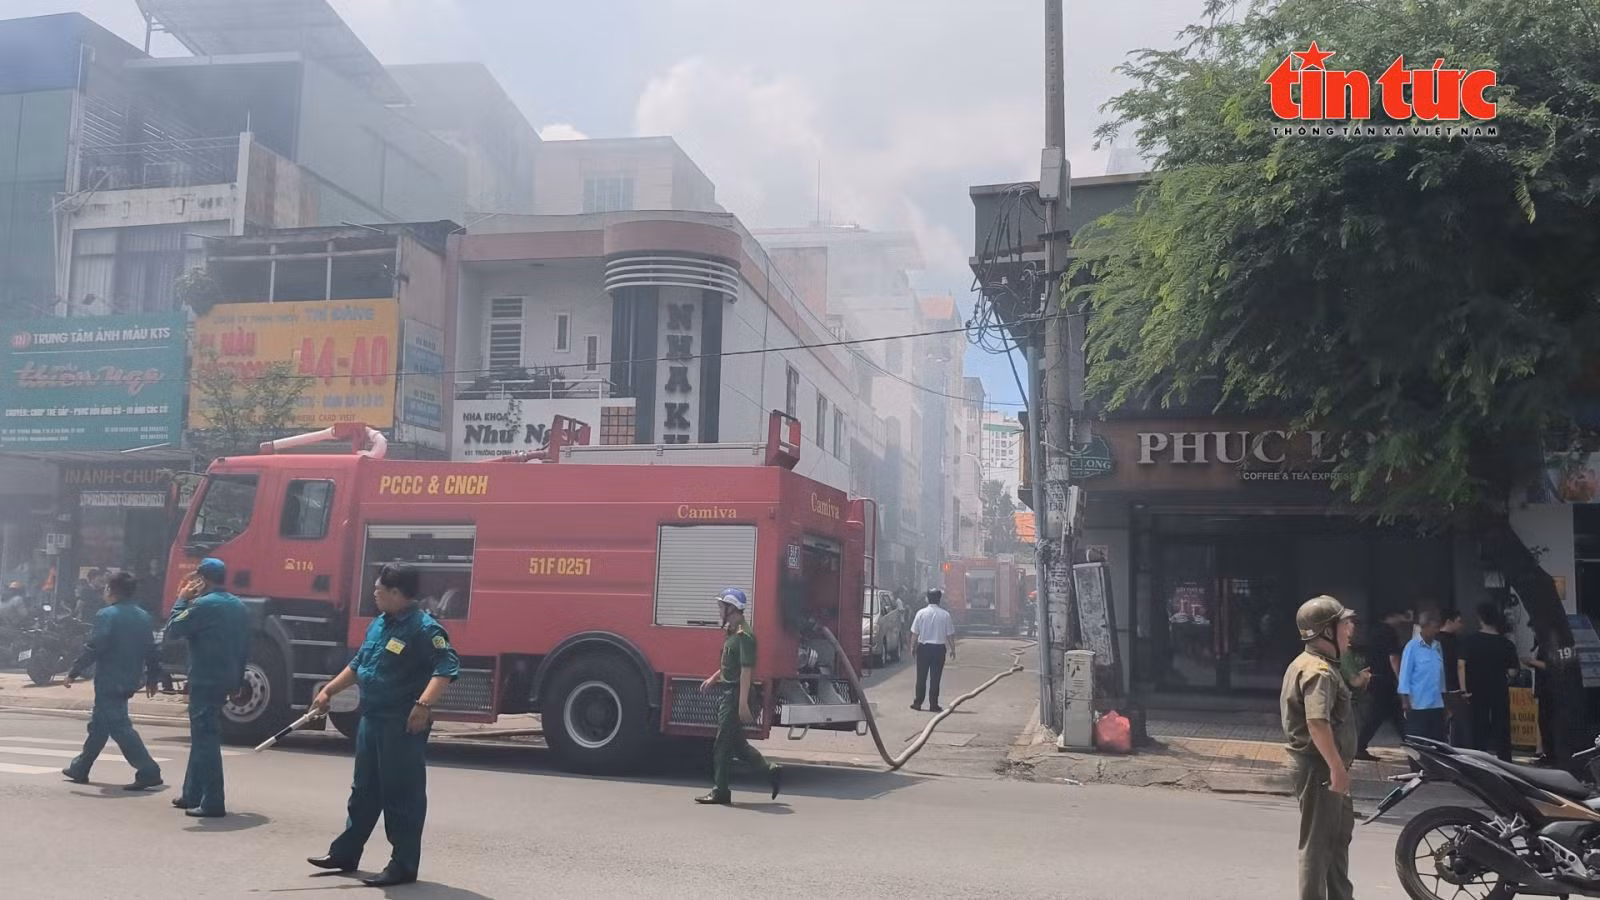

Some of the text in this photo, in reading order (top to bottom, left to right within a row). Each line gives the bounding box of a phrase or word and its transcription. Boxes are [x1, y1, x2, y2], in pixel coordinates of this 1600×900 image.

[33, 333, 68, 344] TRUNG
[71, 329, 93, 343] TÂM
[95, 327, 120, 341] ẢNH
[150, 327, 171, 339] KTS
[463, 412, 508, 422] NHA KHOA
[464, 424, 515, 444] Như
[1136, 430, 1286, 464] PHUC
[379, 475, 489, 495] PCCC & CNCH
[1243, 472, 1279, 481] COFFEE
[1282, 472, 1289, 481] &
[1292, 472, 1310, 481] TEA
[677, 505, 737, 518] Camiva
[811, 492, 839, 519] Camiva
[296, 561, 313, 571] 114
[529, 557, 591, 575] 51F 0251
